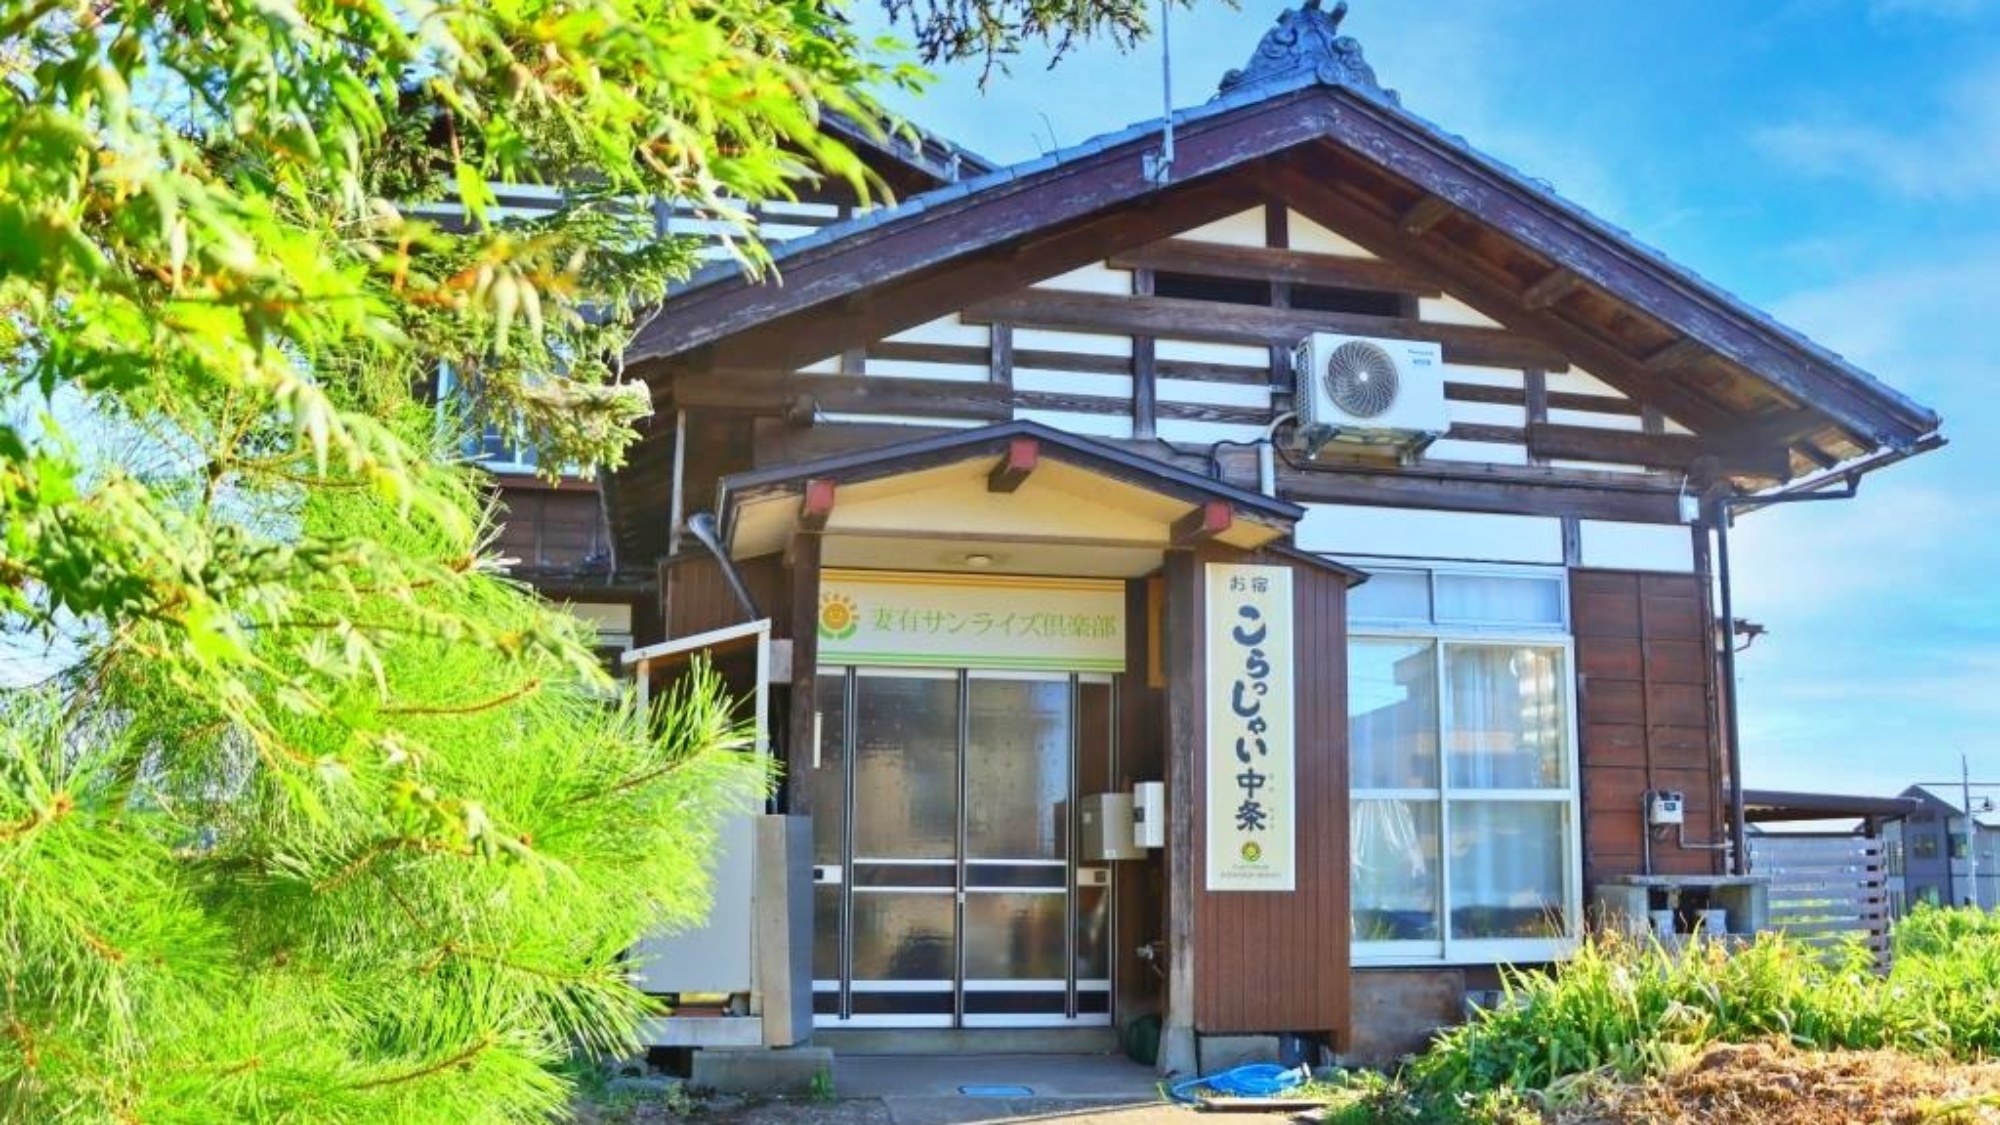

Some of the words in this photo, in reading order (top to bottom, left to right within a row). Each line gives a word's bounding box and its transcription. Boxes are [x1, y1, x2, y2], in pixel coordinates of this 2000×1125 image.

[1232, 605, 1270, 832] こらっしゃい中条
